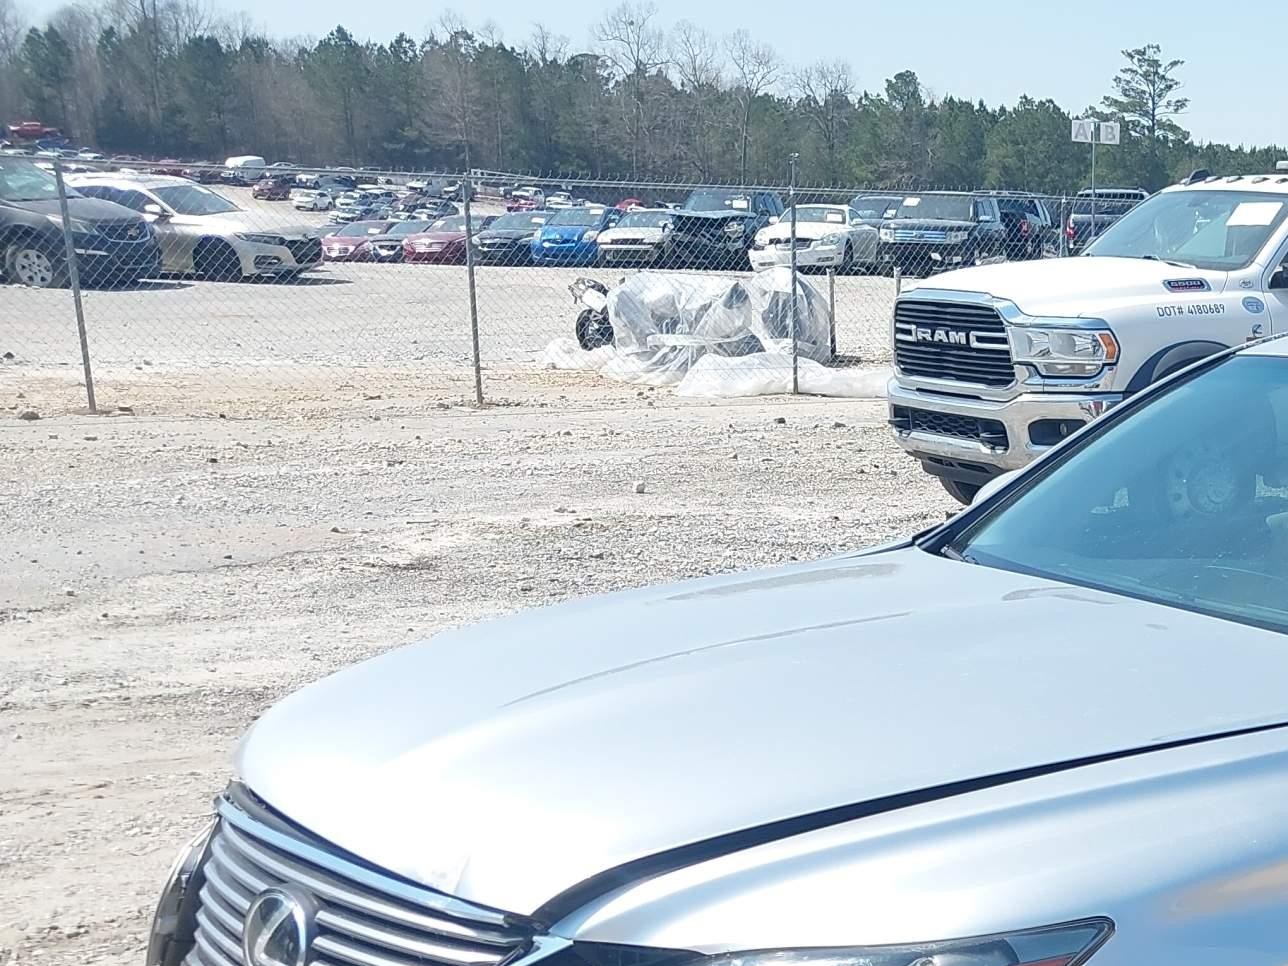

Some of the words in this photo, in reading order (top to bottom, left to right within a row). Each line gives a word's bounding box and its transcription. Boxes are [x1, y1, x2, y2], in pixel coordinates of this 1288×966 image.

[1074, 121, 1090, 141] A
[1103, 124, 1116, 142] B
[1157, 305, 1185, 317] DOT#
[1187, 303, 1226, 316] 4180689
[916, 327, 967, 345] RAM
